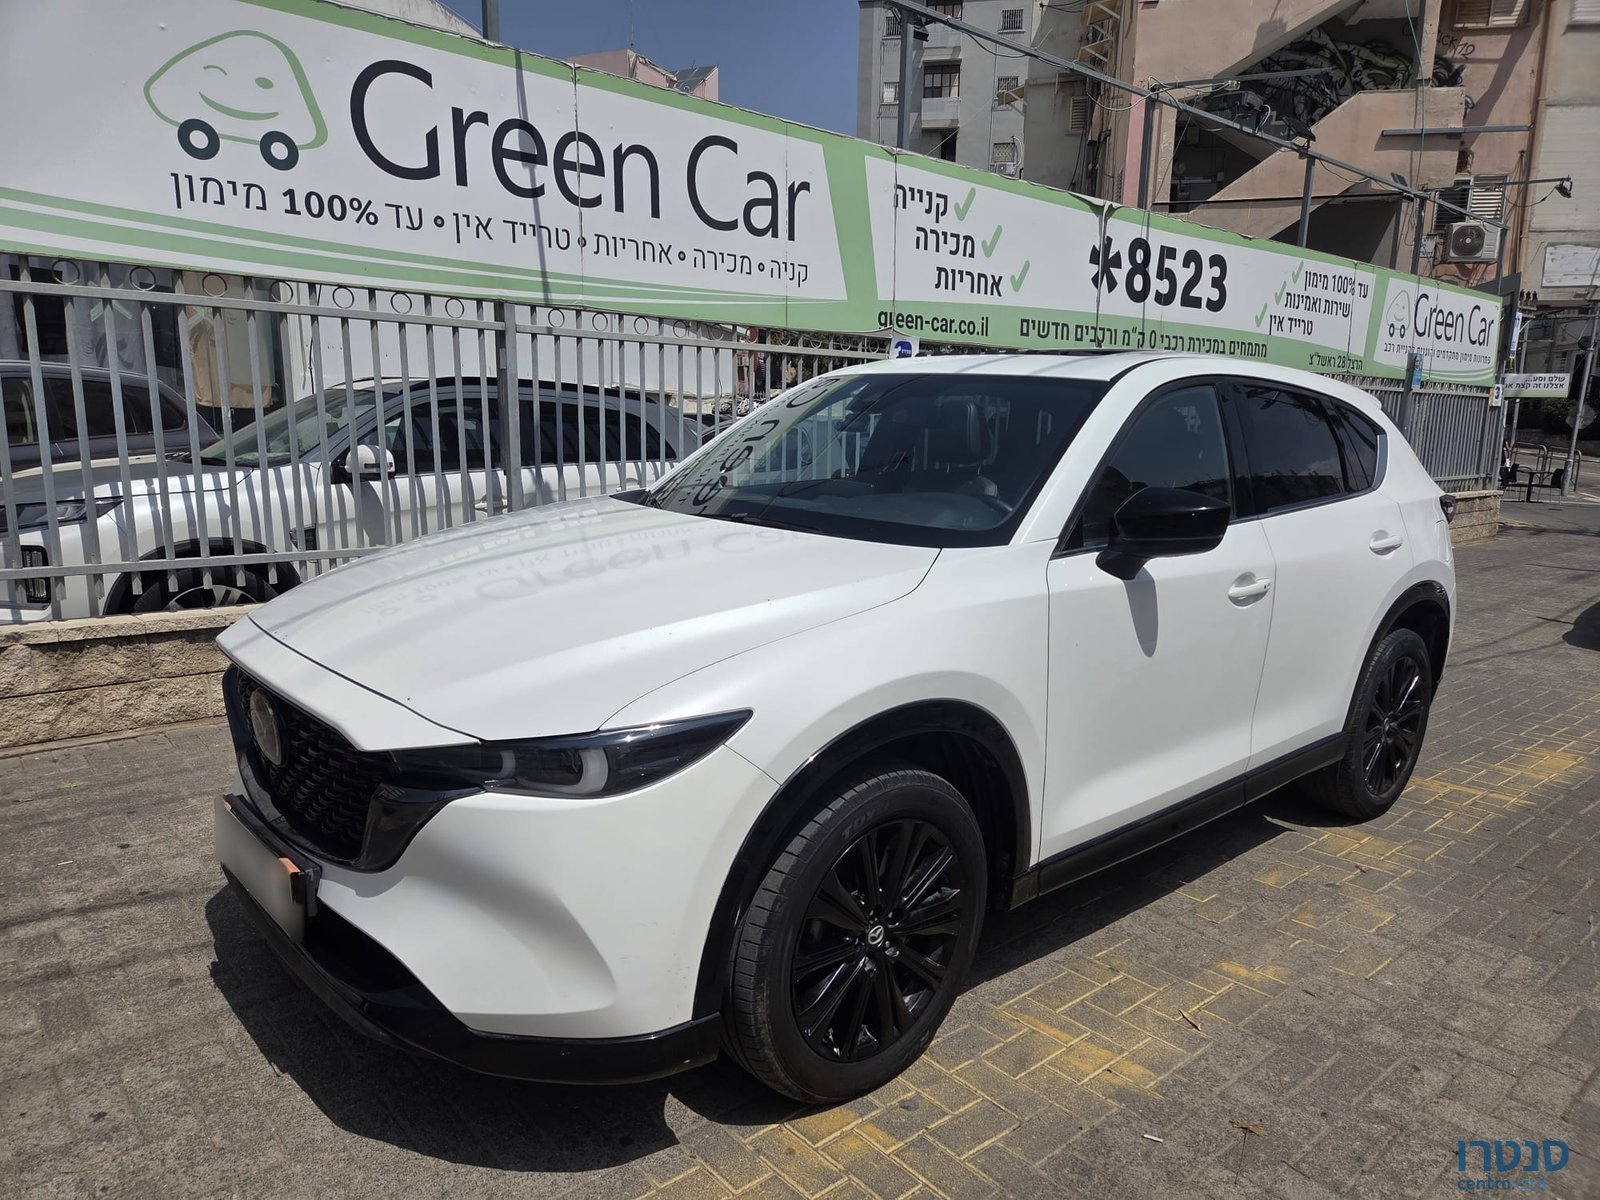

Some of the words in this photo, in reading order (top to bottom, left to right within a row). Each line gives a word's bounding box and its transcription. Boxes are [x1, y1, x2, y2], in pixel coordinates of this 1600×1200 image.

[350, 59, 660, 219] Green
[686, 134, 811, 243] Car
[170, 172, 267, 211] מימון
[894, 184, 948, 223] קנייה
[282, 188, 379, 226] 100%
[385, 202, 423, 231] עד
[452, 212, 493, 244] אין
[502, 219, 571, 251] טרייד
[593, 233, 673, 265] אחריות
[915, 226, 976, 259] מכירה
[693, 248, 752, 276] מכירה
[770, 260, 808, 288] קניה
[934, 266, 1003, 297] אחריות
[1304, 270, 1329, 292] מימון
[1332, 273, 1356, 297] 100%
[1358, 282, 1369, 299] עד
[1284, 291, 1321, 314] ואמינות
[1323, 299, 1351, 318] שירות
[878, 310, 989, 337] green-car.co.il
[1020, 318, 1070, 341] חדשים
[1269, 314, 1285, 335] אין
[1287, 317, 1314, 336] טרייד
[1414, 293, 1465, 343] Green
[1468, 305, 1495, 347] Car
[1160, 333, 1184, 352] רכבי
[1187, 336, 1226, 355] במכירת
[1228, 340, 1267, 358] מתמחים
